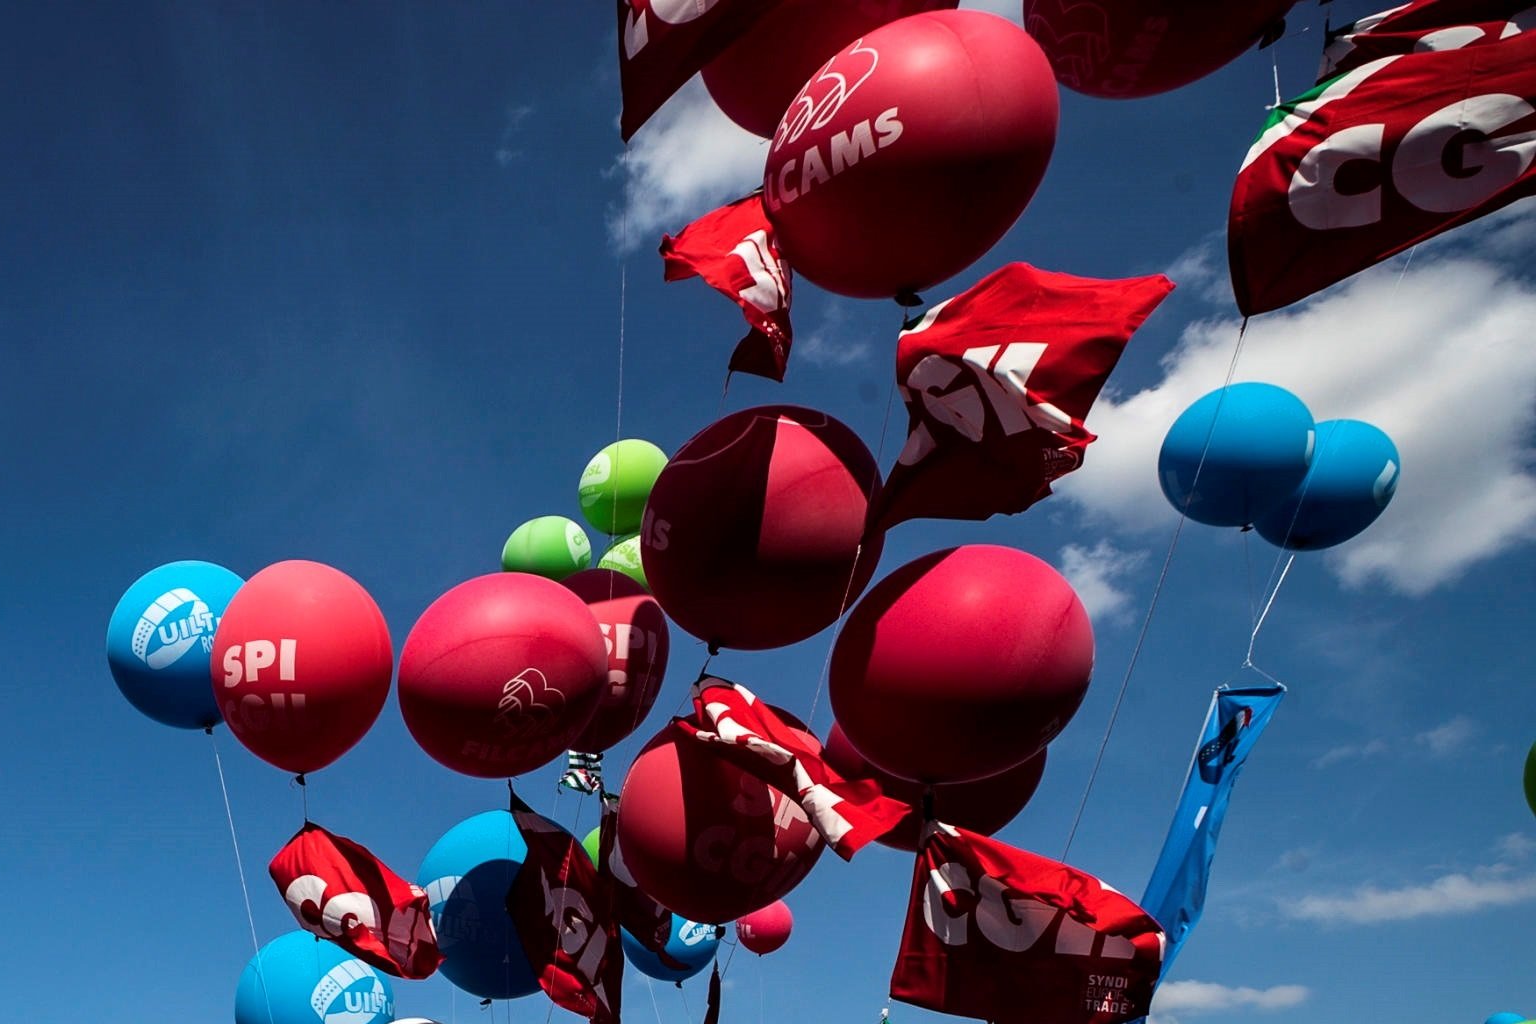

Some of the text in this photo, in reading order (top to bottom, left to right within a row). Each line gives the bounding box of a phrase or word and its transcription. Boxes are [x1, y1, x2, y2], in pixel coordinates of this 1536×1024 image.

[765, 106, 903, 212] LCAMS
[223, 638, 297, 688] SPI
[225, 693, 319, 734] CGIL
[1085, 1000, 1128, 1014] TRADE
